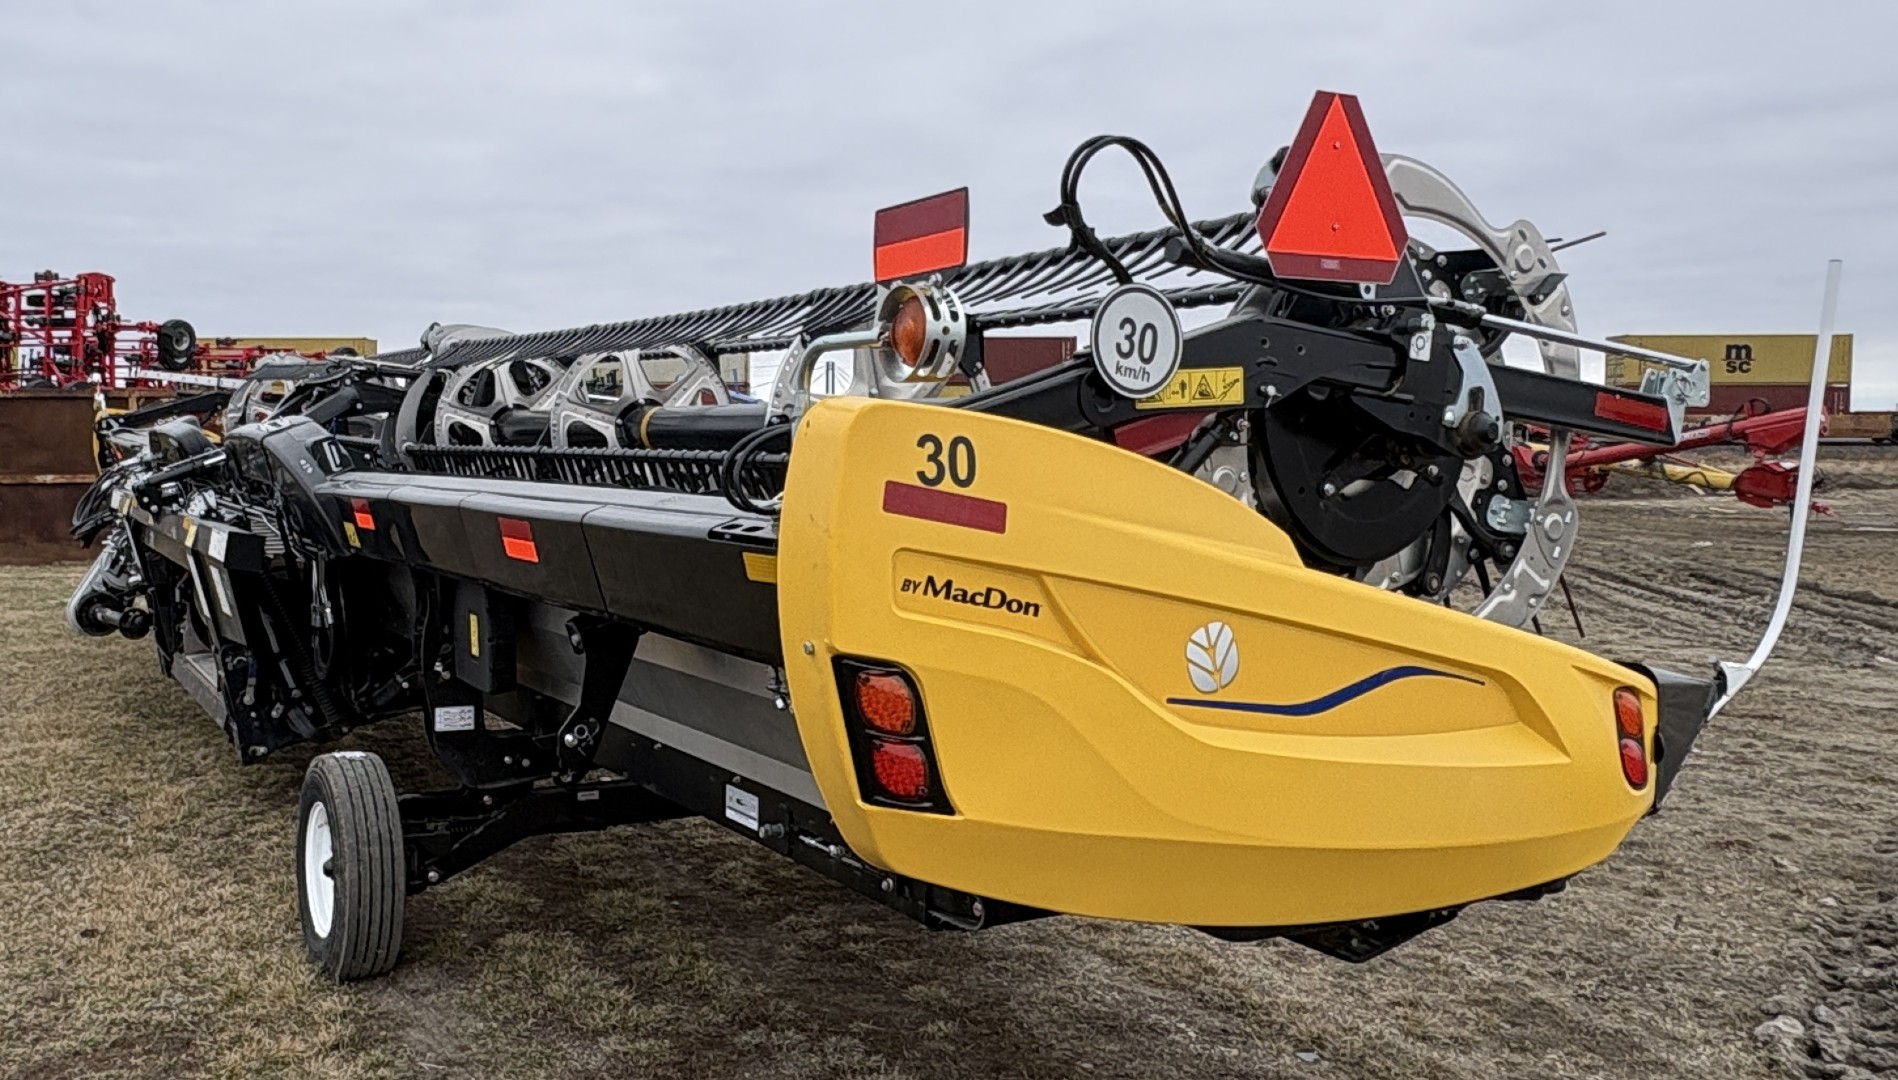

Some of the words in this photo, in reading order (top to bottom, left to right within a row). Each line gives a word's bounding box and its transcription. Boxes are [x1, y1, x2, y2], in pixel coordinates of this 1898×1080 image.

[1115, 317, 1158, 365] 30
[1115, 361, 1150, 382] km/h
[916, 433, 976, 488] 30
[901, 578, 921, 594] BY
[923, 575, 1040, 617] MacDon
